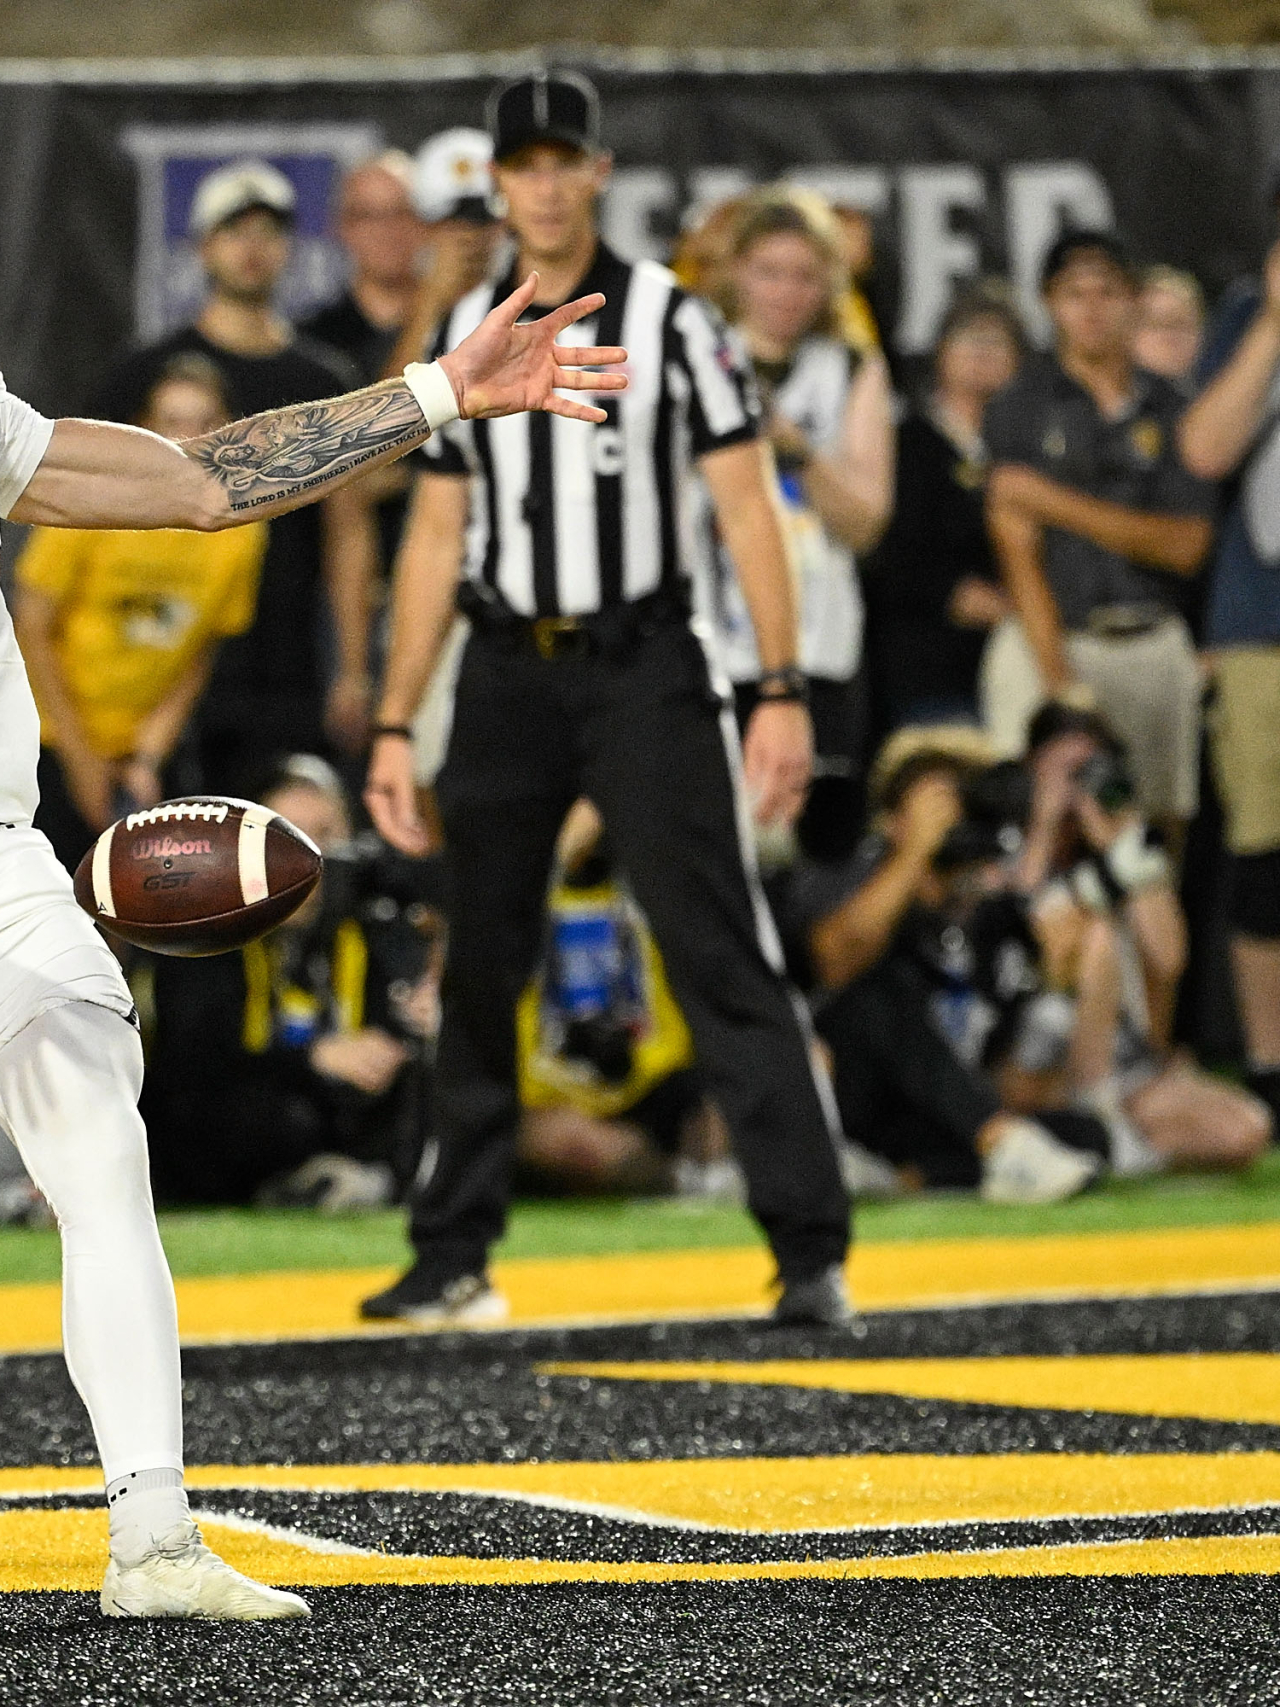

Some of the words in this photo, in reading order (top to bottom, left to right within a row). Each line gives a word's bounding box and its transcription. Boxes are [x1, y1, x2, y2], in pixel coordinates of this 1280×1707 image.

[231, 501, 250, 511] THE
[251, 494, 275, 507] LORD
[277, 490, 286, 499] IS
[287, 484, 301, 495] MY
[354, 449, 376, 466] HAVE
[377, 442, 394, 455] ALL
[394, 430, 416, 446] THAT
[132, 836, 211, 860] Wilson
[143, 871, 199, 891] GST
